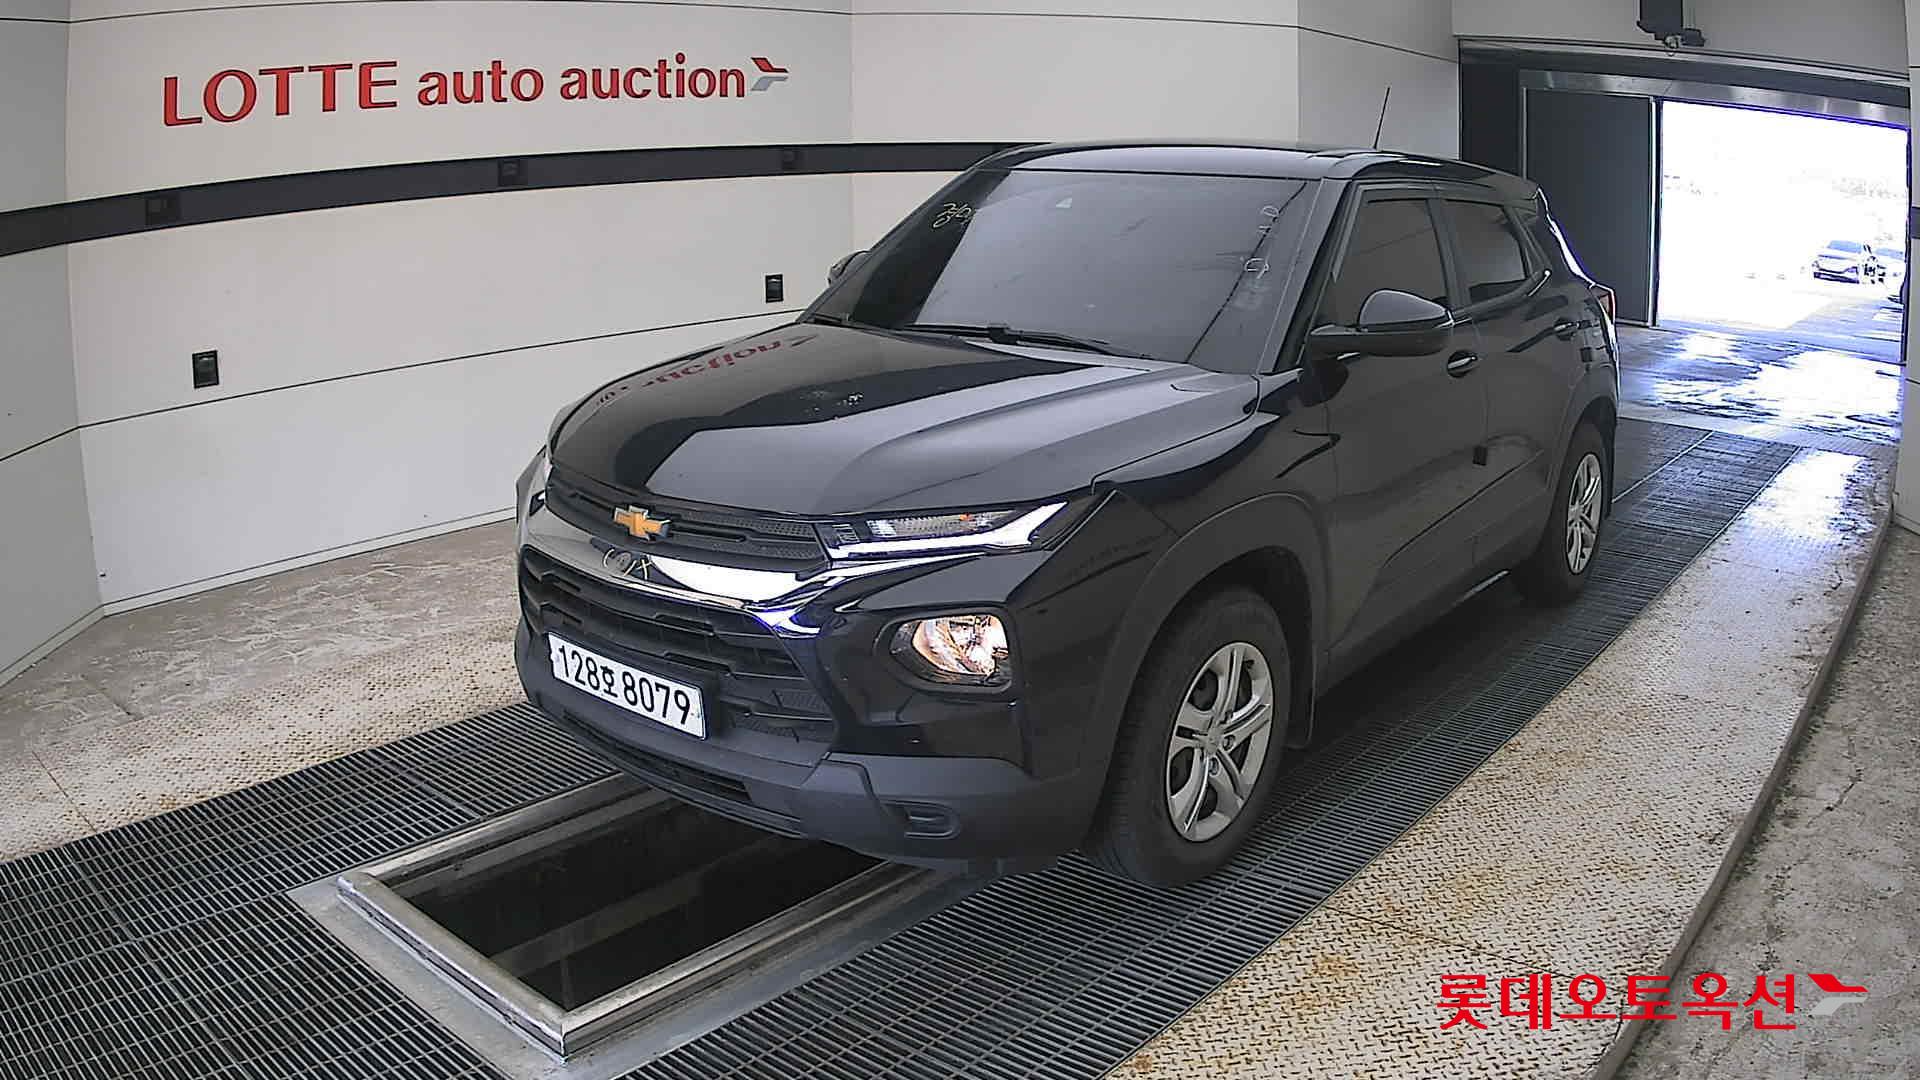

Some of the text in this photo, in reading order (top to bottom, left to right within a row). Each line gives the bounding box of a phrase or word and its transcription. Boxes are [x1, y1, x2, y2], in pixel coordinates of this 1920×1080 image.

[163, 53, 746, 126] LOTTE auto auction
